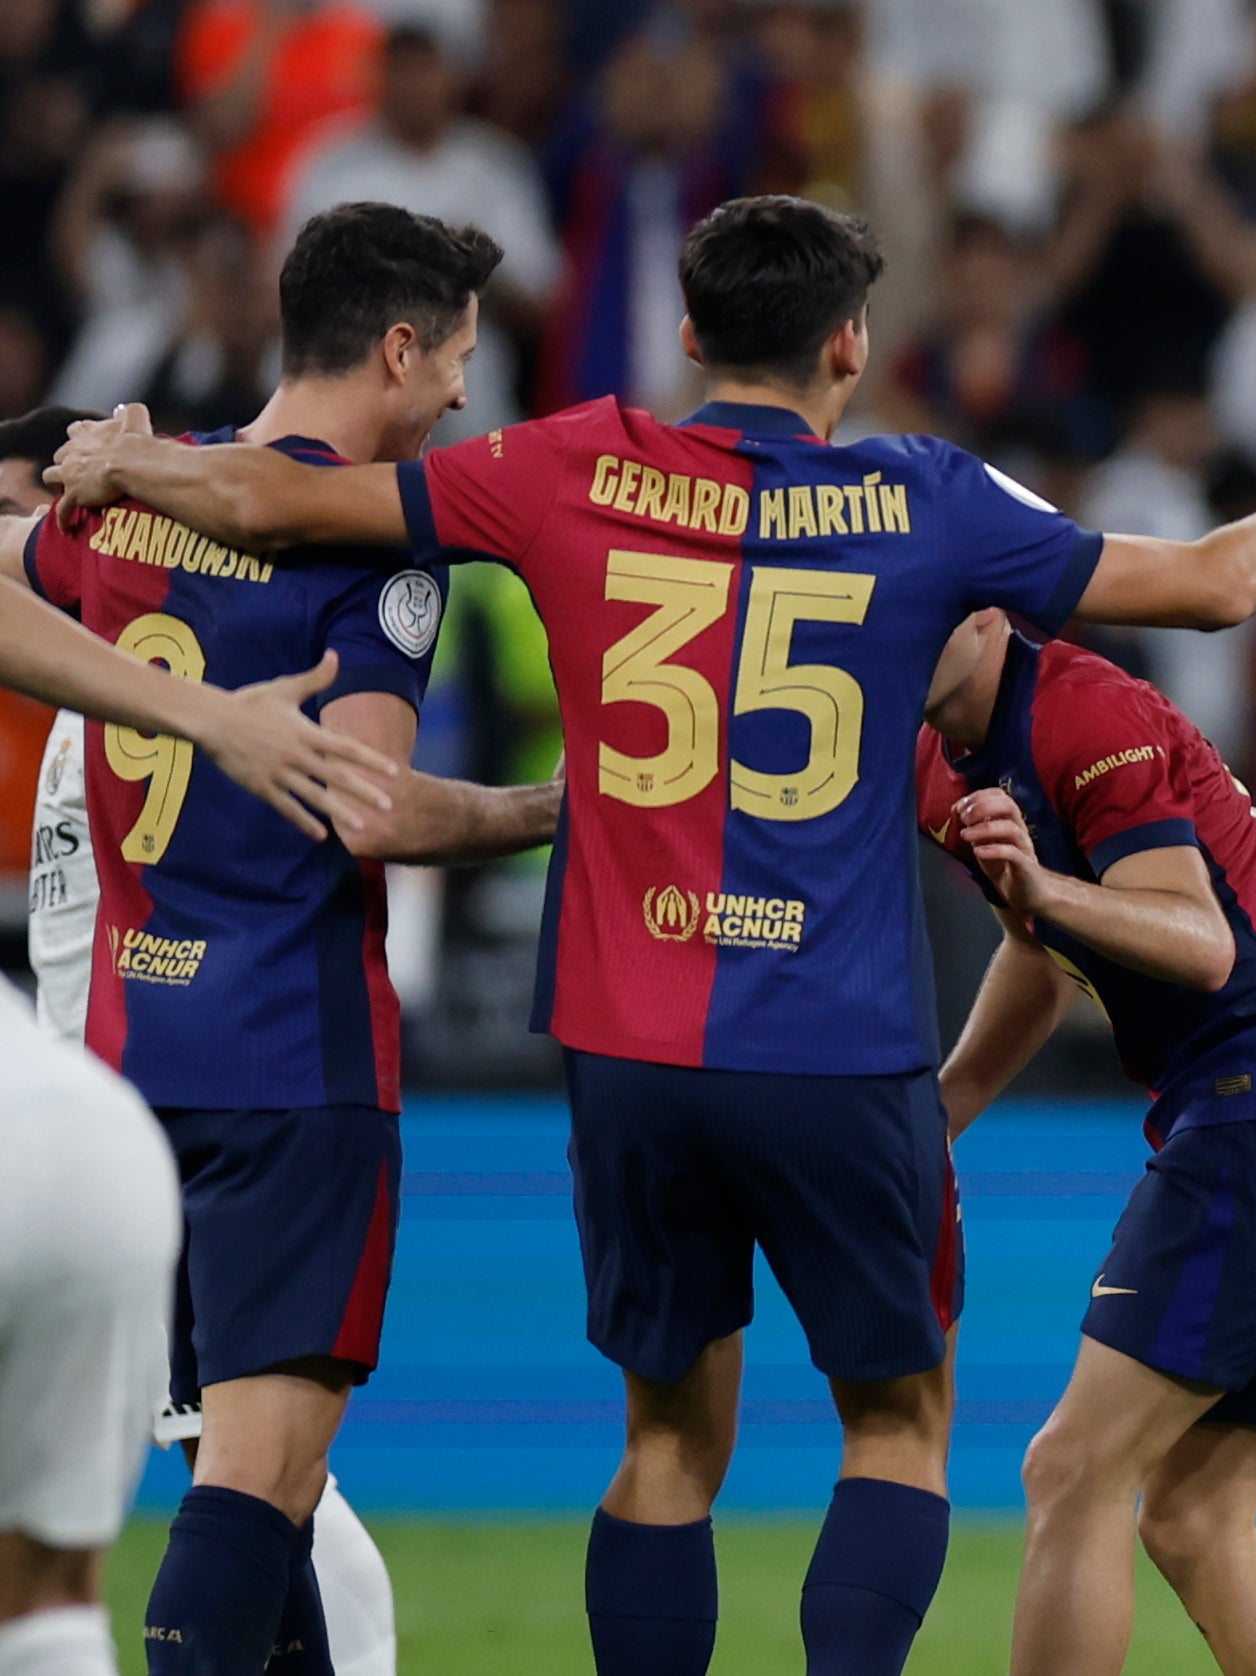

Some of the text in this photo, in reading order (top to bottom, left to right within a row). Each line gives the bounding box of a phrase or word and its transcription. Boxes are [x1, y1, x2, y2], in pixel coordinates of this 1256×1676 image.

[589, 454, 911, 540] GERARD MARTÍN
[598, 549, 877, 822] 35
[103, 612, 206, 866] 9
[1074, 745, 1155, 790] AMBILIGHT
[705, 892, 805, 922] UNHCR
[122, 928, 207, 960] UNHCR
[703, 914, 802, 943] ACNUR
[117, 948, 200, 978] ACNUR
